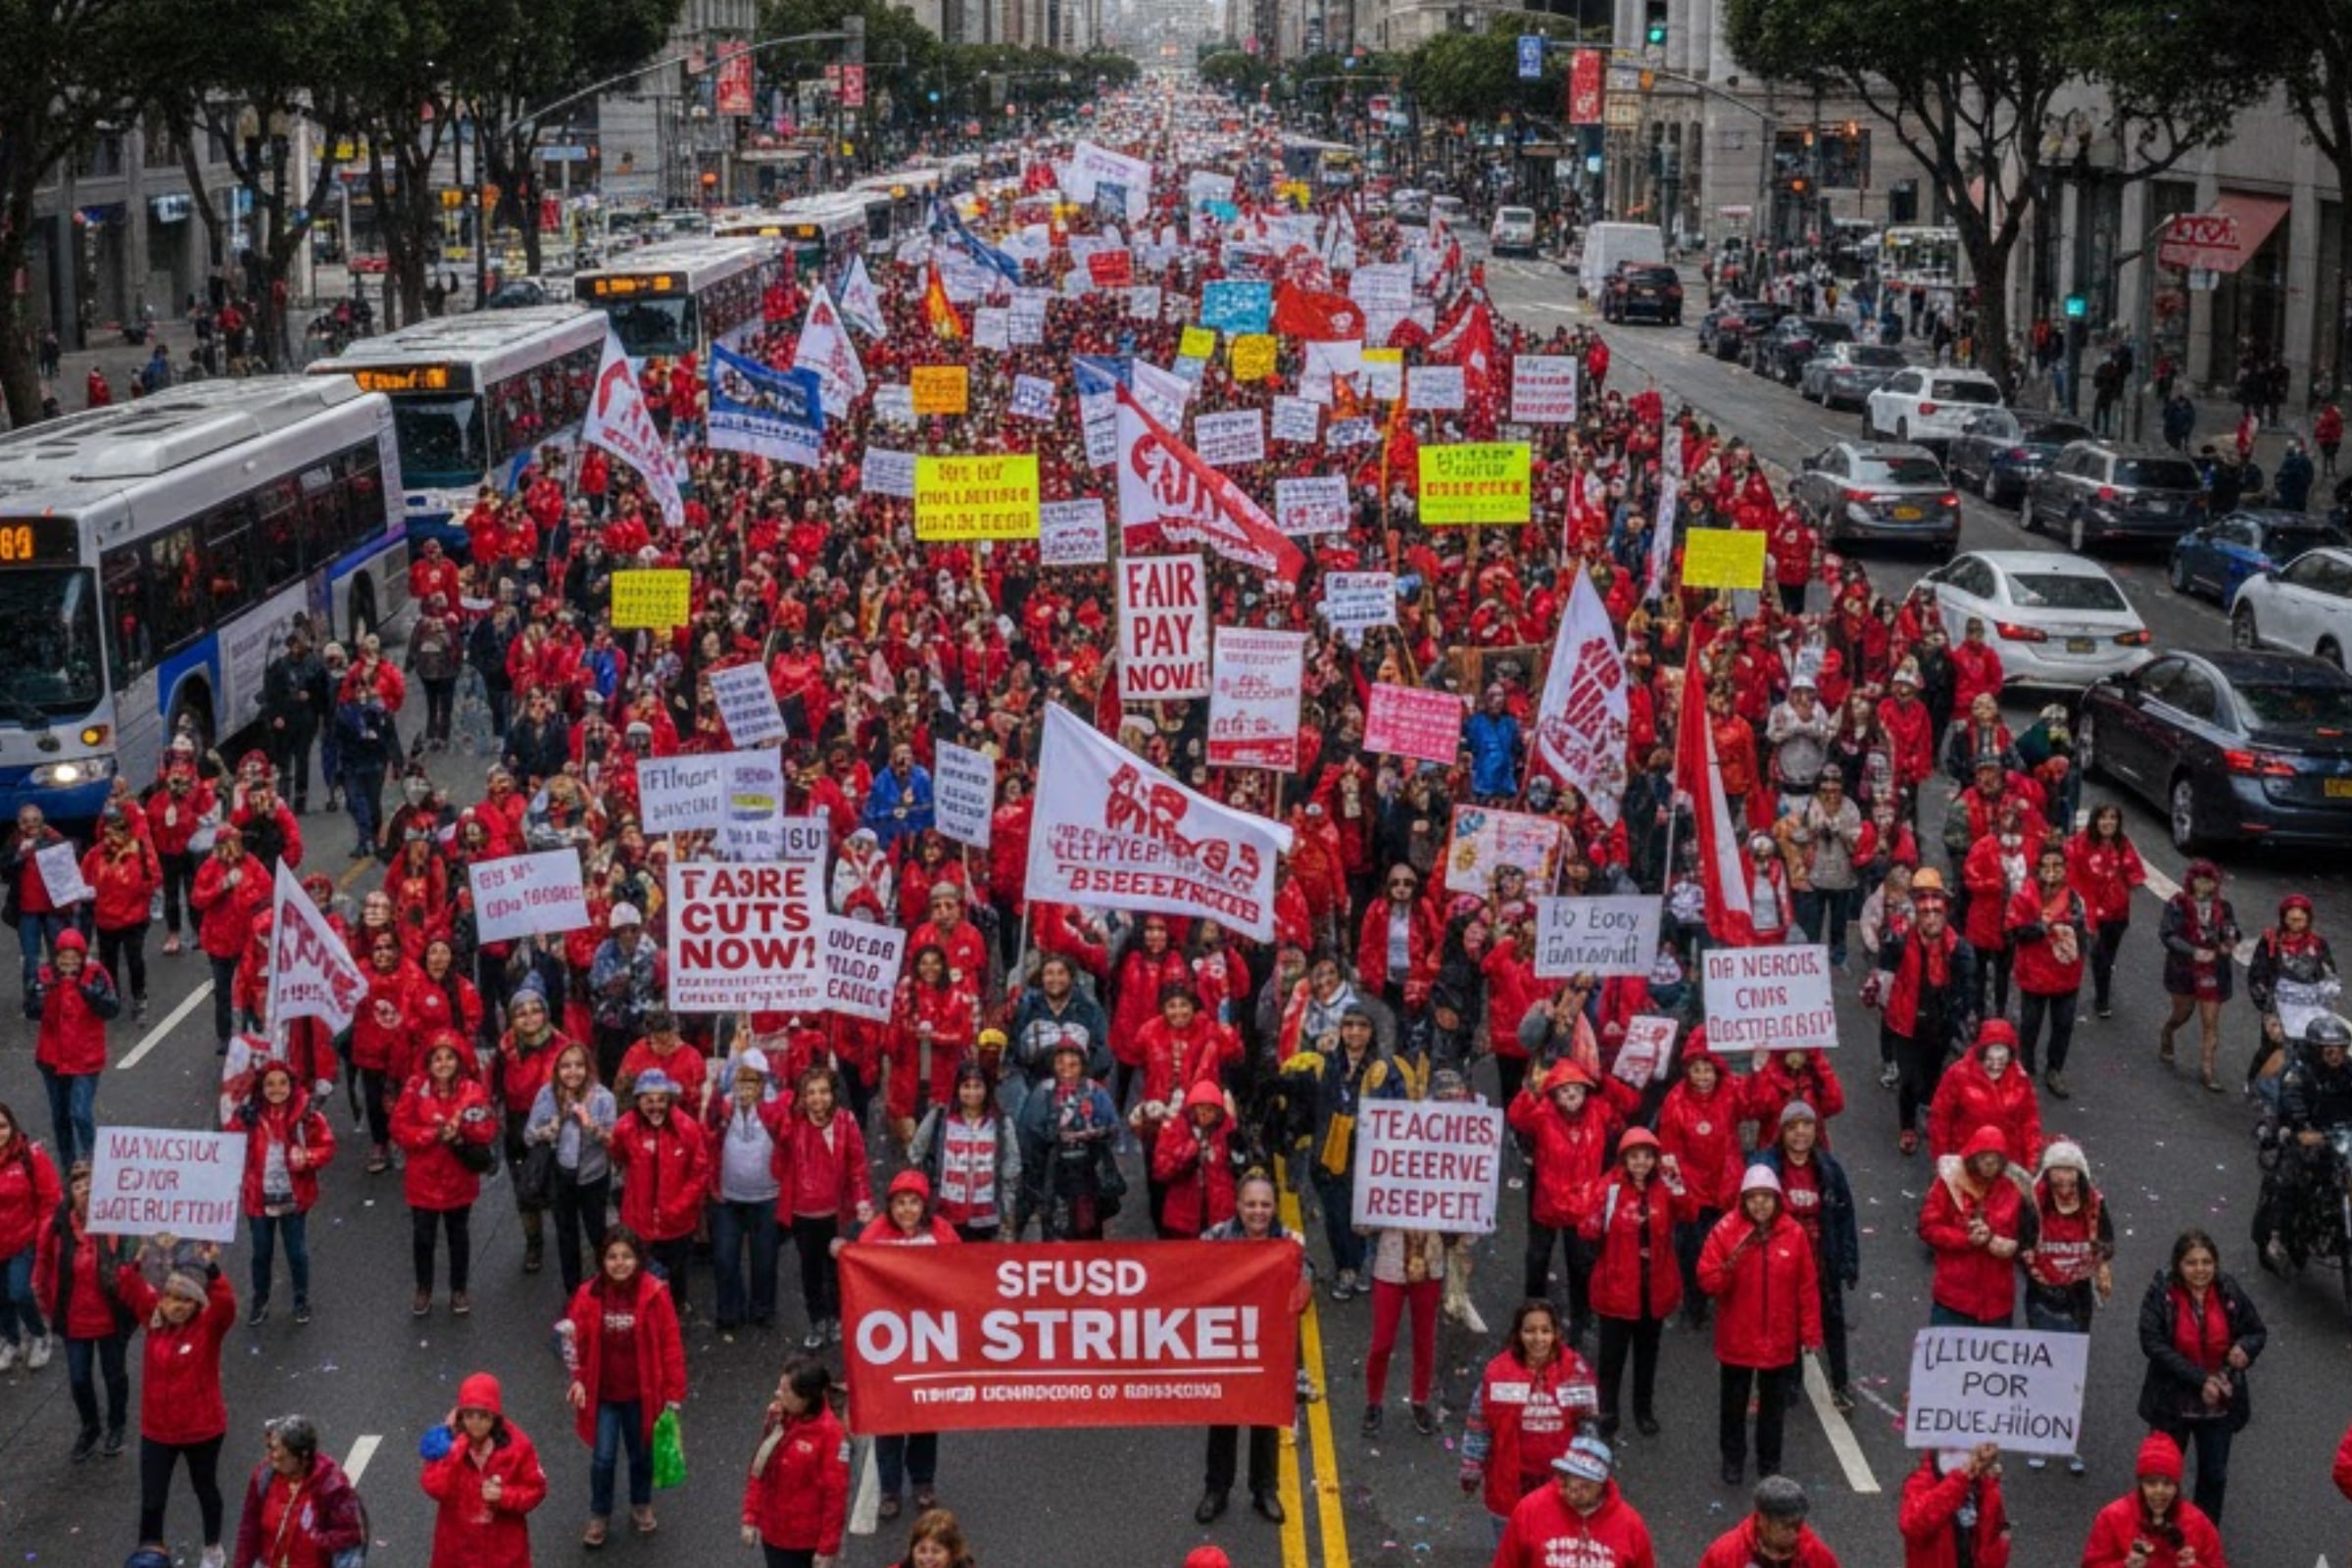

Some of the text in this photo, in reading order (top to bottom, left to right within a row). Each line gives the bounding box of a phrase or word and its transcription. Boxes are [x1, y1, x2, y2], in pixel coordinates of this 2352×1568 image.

[1128, 563, 1198, 608] FAIR
[1134, 613, 1194, 657] PAY
[1128, 661, 1204, 692] NOW!
[681, 903, 810, 935] CUTS
[996, 1260, 1148, 1298] SFUSD
[856, 1305, 1260, 1365] ON STRIKE!
[1962, 1371, 2028, 1398] POR
